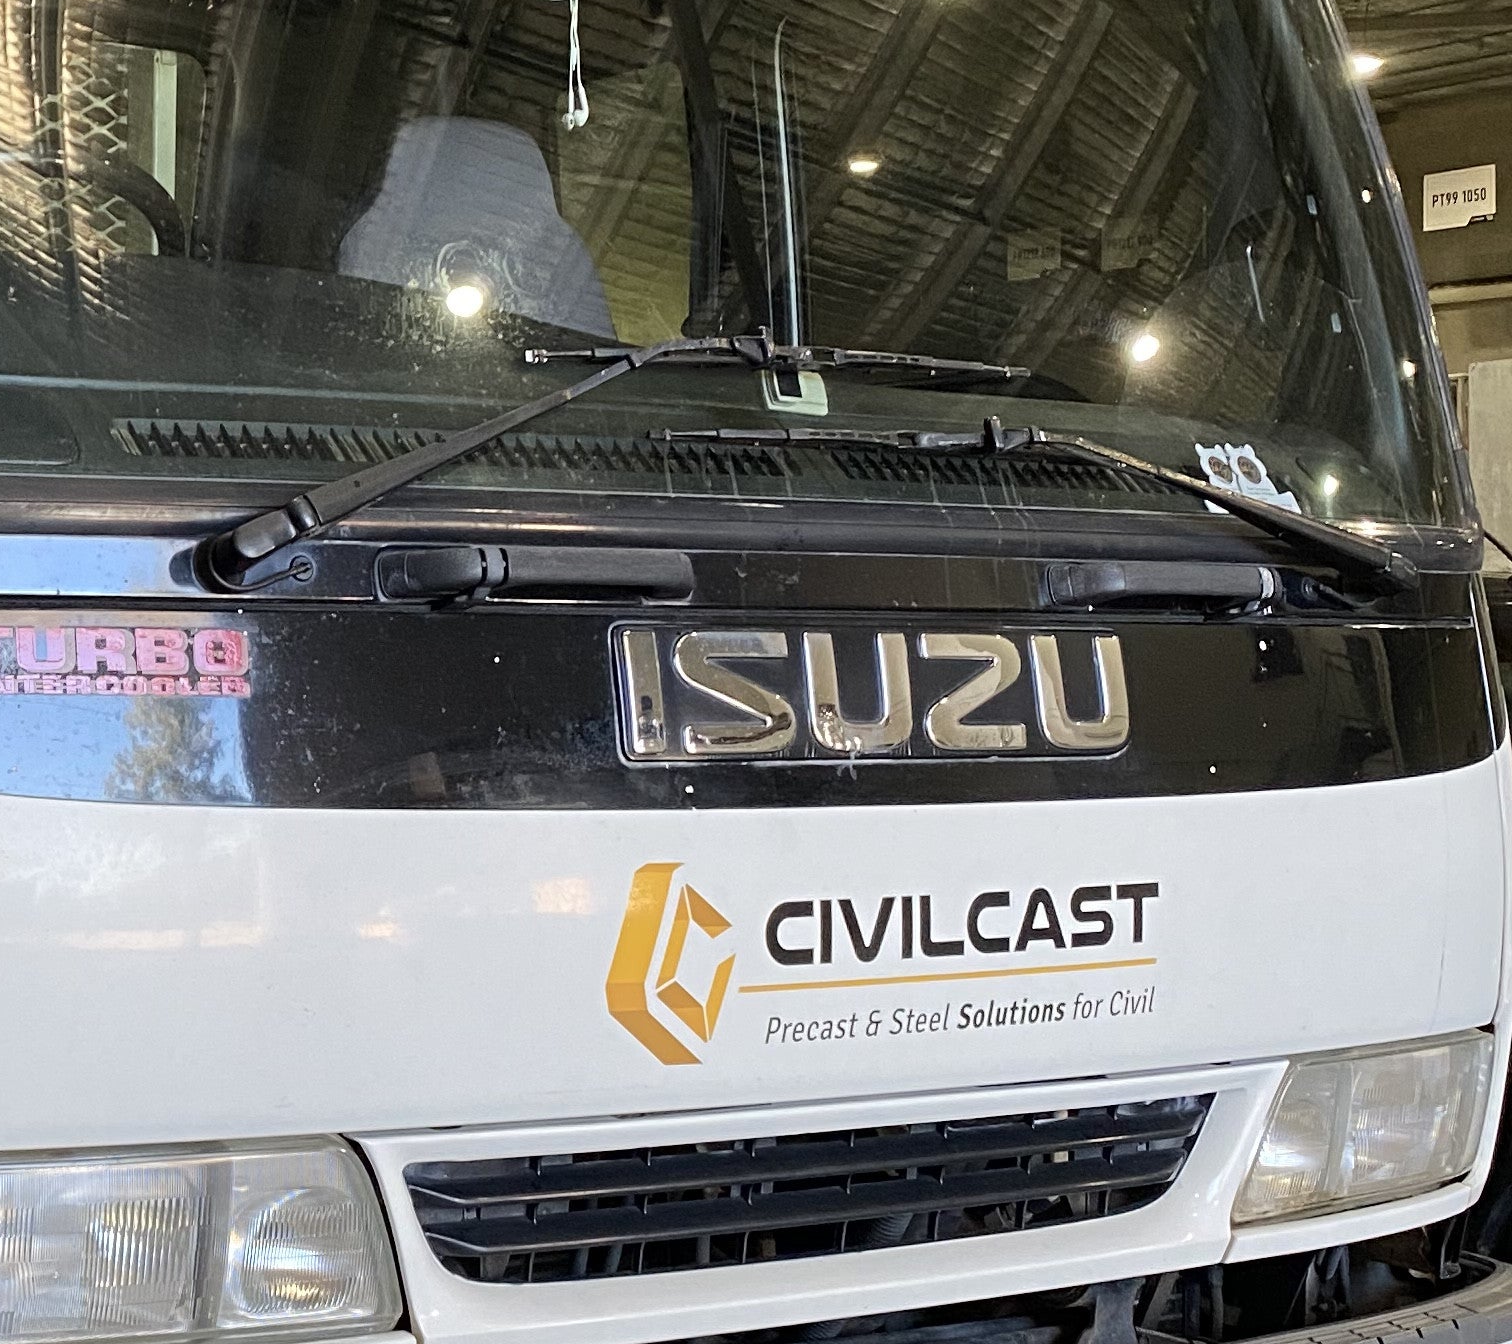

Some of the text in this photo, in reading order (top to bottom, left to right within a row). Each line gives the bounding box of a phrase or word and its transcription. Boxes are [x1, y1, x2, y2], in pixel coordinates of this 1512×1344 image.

[1432, 187, 1487, 208] PT99 1050
[623, 630, 1130, 755] ISUZU
[764, 882, 1160, 966] CIVILCAST
[764, 986, 1155, 1045] Precast & Steel Solutions for Civil
